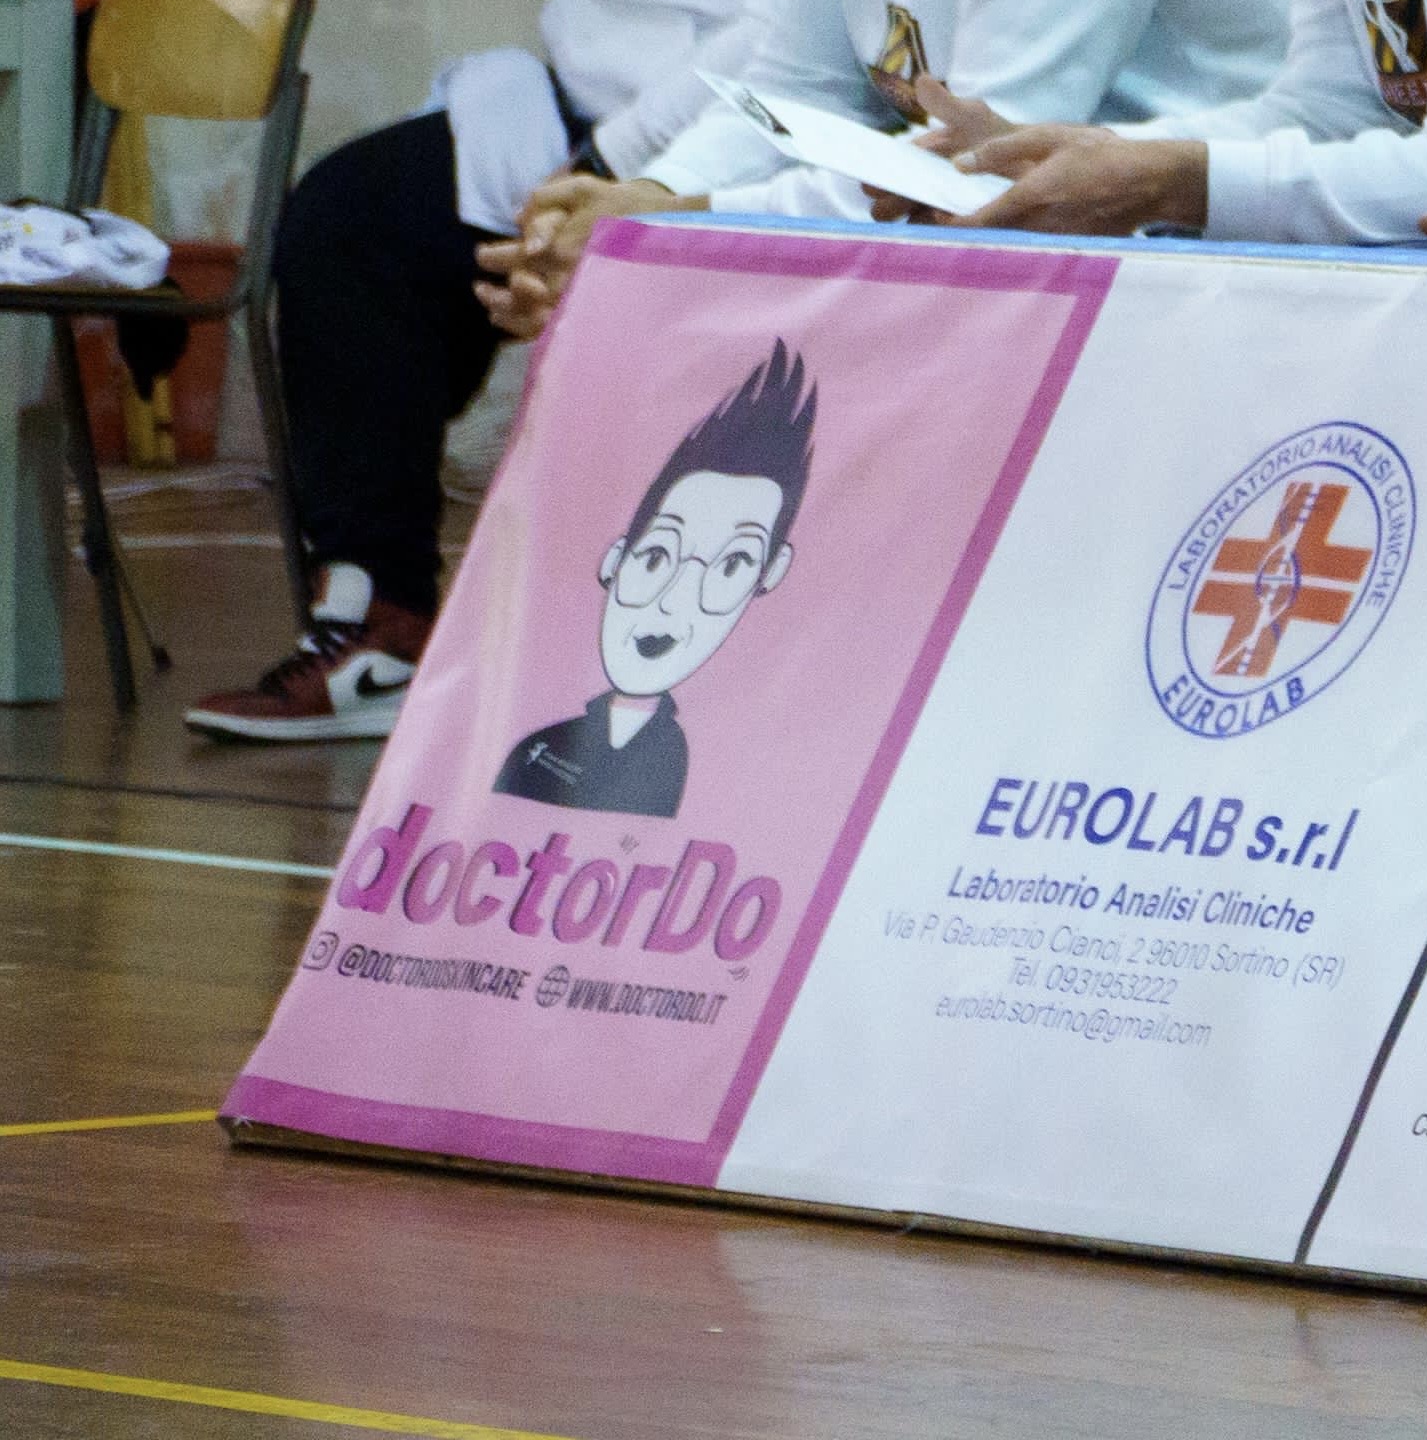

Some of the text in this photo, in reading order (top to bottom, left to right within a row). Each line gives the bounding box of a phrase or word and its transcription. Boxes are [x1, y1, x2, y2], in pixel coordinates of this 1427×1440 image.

[1168, 434, 1405, 608] LABORATORIO ANALISI CLINICHE
[1162, 674, 1305, 736] EUROLAB
[975, 778, 1361, 871] EUROLAB s.r.l
[336, 802, 783, 961] doctorDo
[947, 866, 1315, 935] Laboratorio Analisi Cliniche
[885, 912, 915, 939] Via
[943, 916, 1044, 950] Gaudenzio
[1146, 939, 1210, 970] 96010
[1211, 943, 1289, 978] Sortino
[1293, 953, 1345, 991] (SR)
[1046, 964, 1178, 1004] 0931953222
[566, 978, 728, 1025] WWW.DOCTORDO.IT
